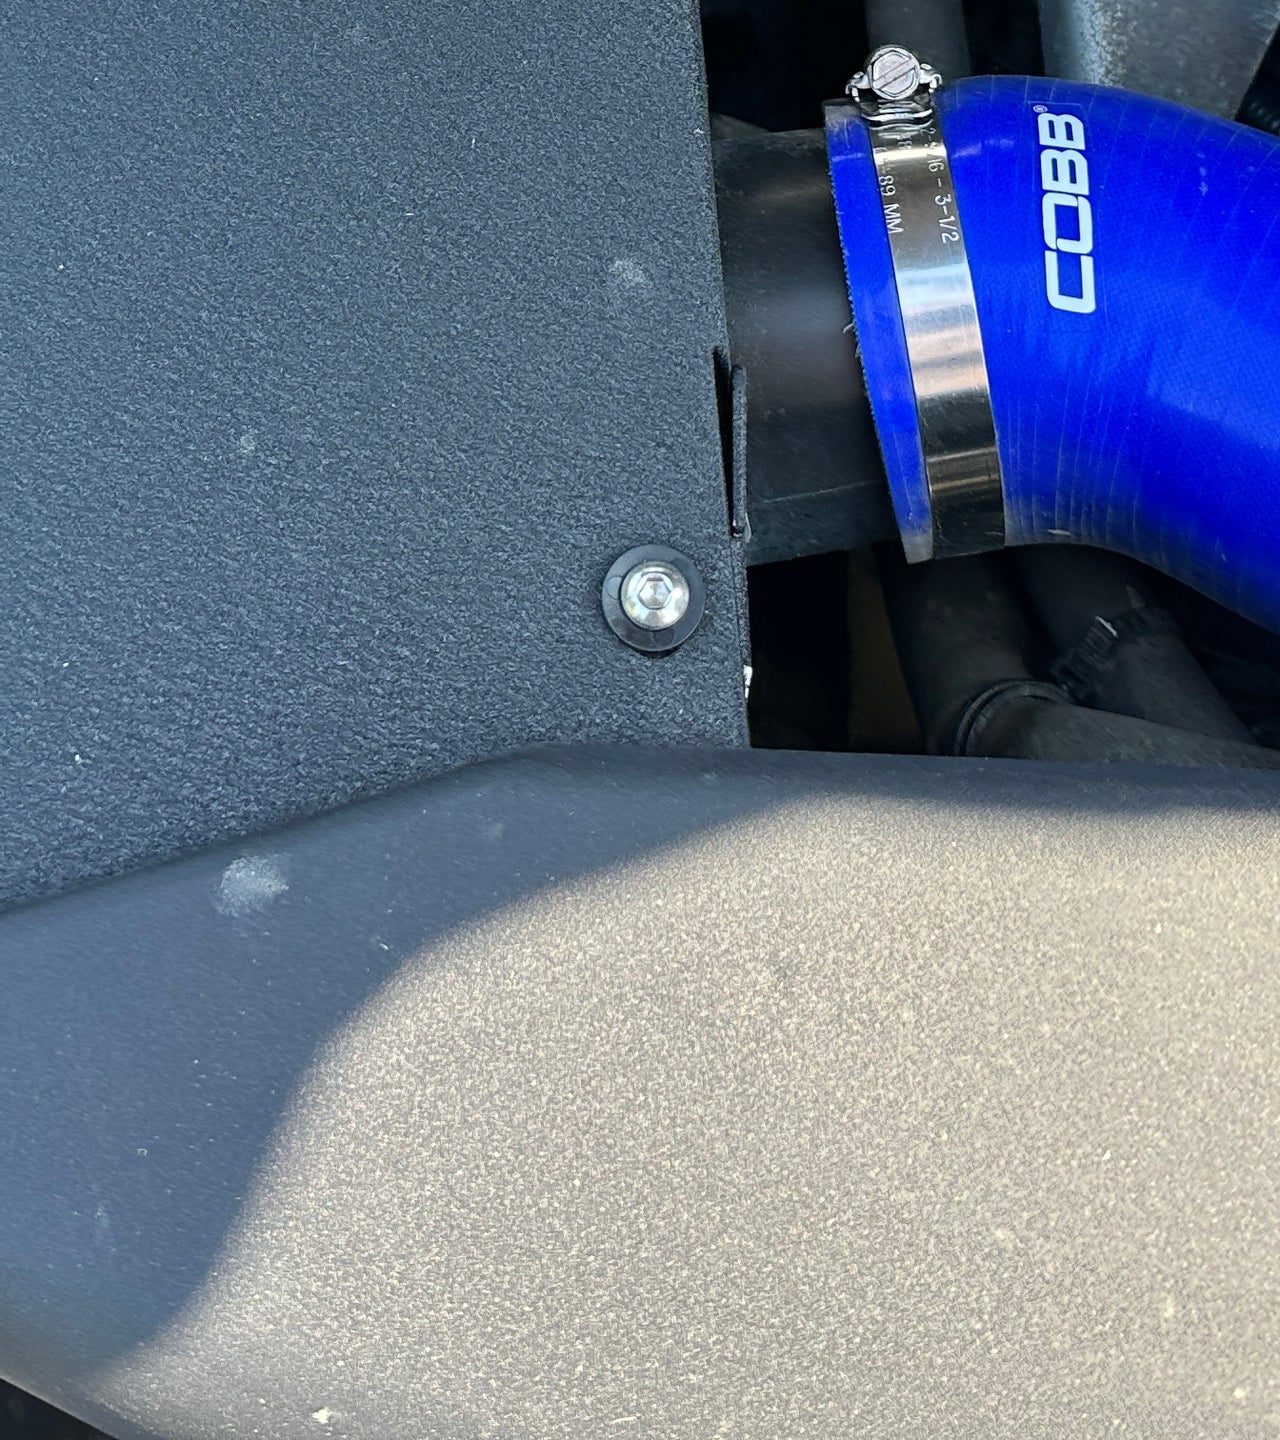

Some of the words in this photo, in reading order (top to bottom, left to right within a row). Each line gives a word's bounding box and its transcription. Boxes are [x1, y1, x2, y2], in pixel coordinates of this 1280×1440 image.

[878, 175, 896, 197] 89
[882, 203, 905, 234] MM
[934, 193, 961, 244] 3-1/2
[1037, 111, 1097, 314] COBB
